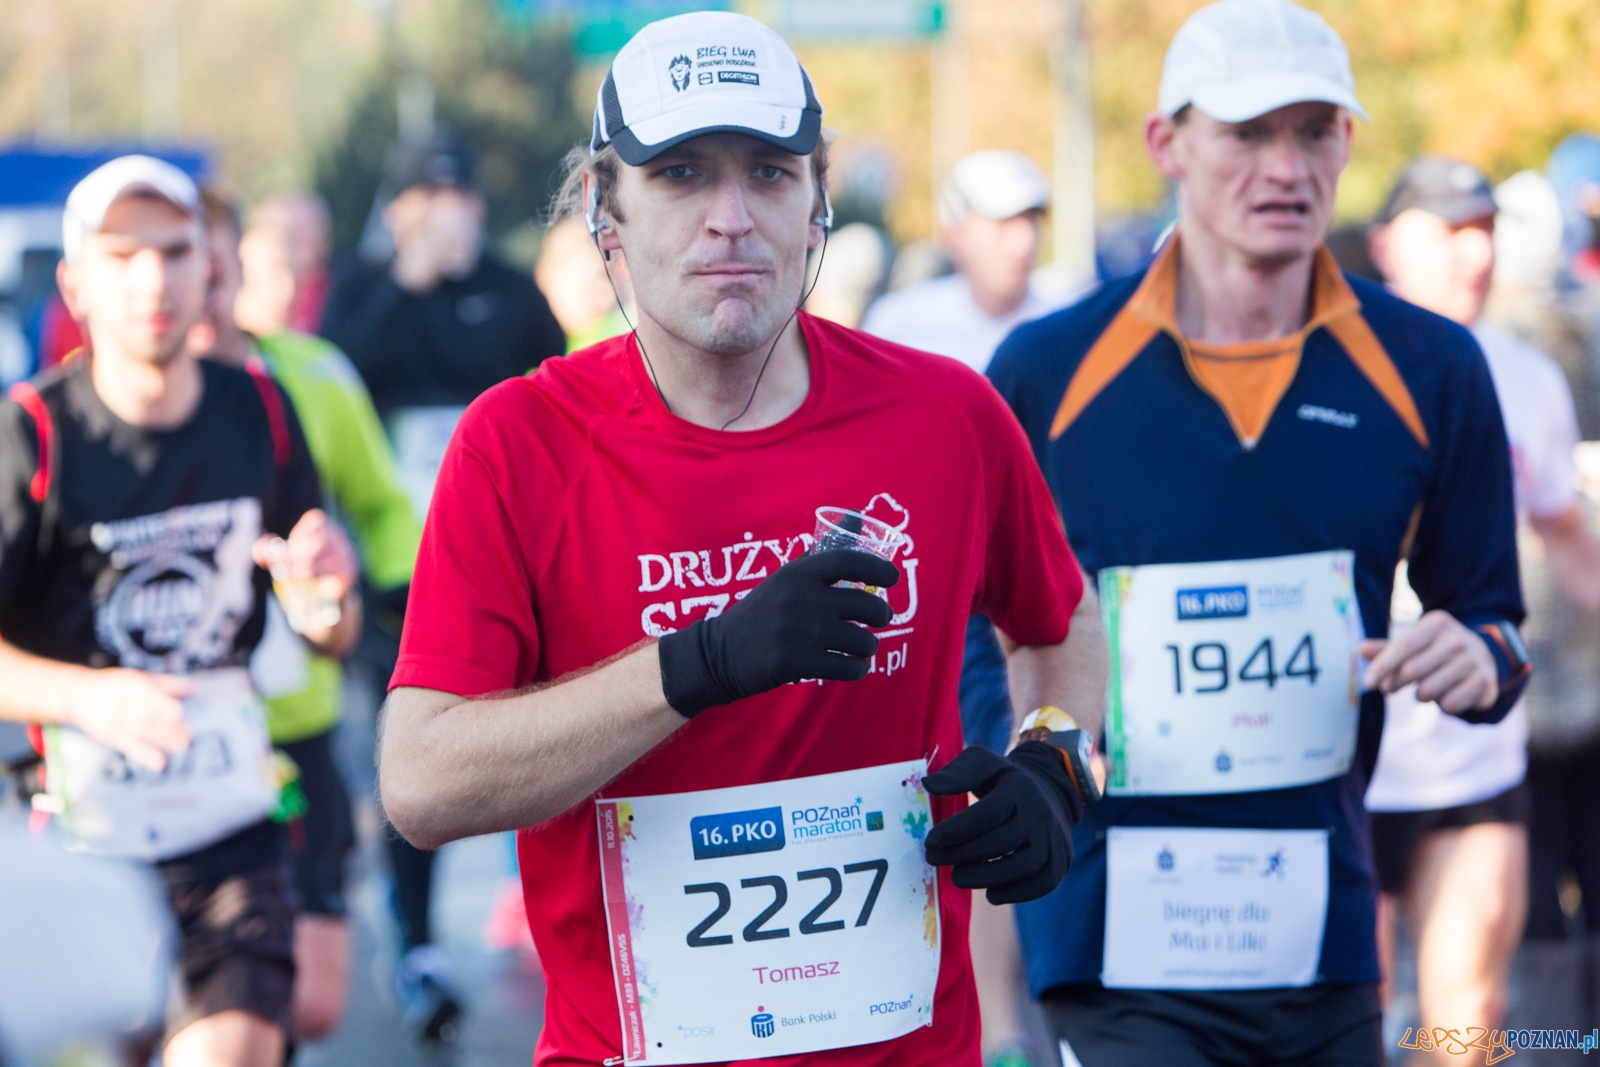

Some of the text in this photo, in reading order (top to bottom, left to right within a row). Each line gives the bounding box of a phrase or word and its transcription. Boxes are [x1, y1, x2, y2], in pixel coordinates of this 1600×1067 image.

[696, 45, 756, 59] BIEG LWA
[1165, 633, 1320, 694] 1944
[699, 820, 777, 846] 16. PKO
[793, 818, 862, 839] maraton
[683, 858, 889, 948] 2227
[752, 960, 841, 985] Tomasz
[624, 983, 635, 1004] M33
[780, 1016, 806, 1027] Bank
[809, 1011, 837, 1023] Polski
